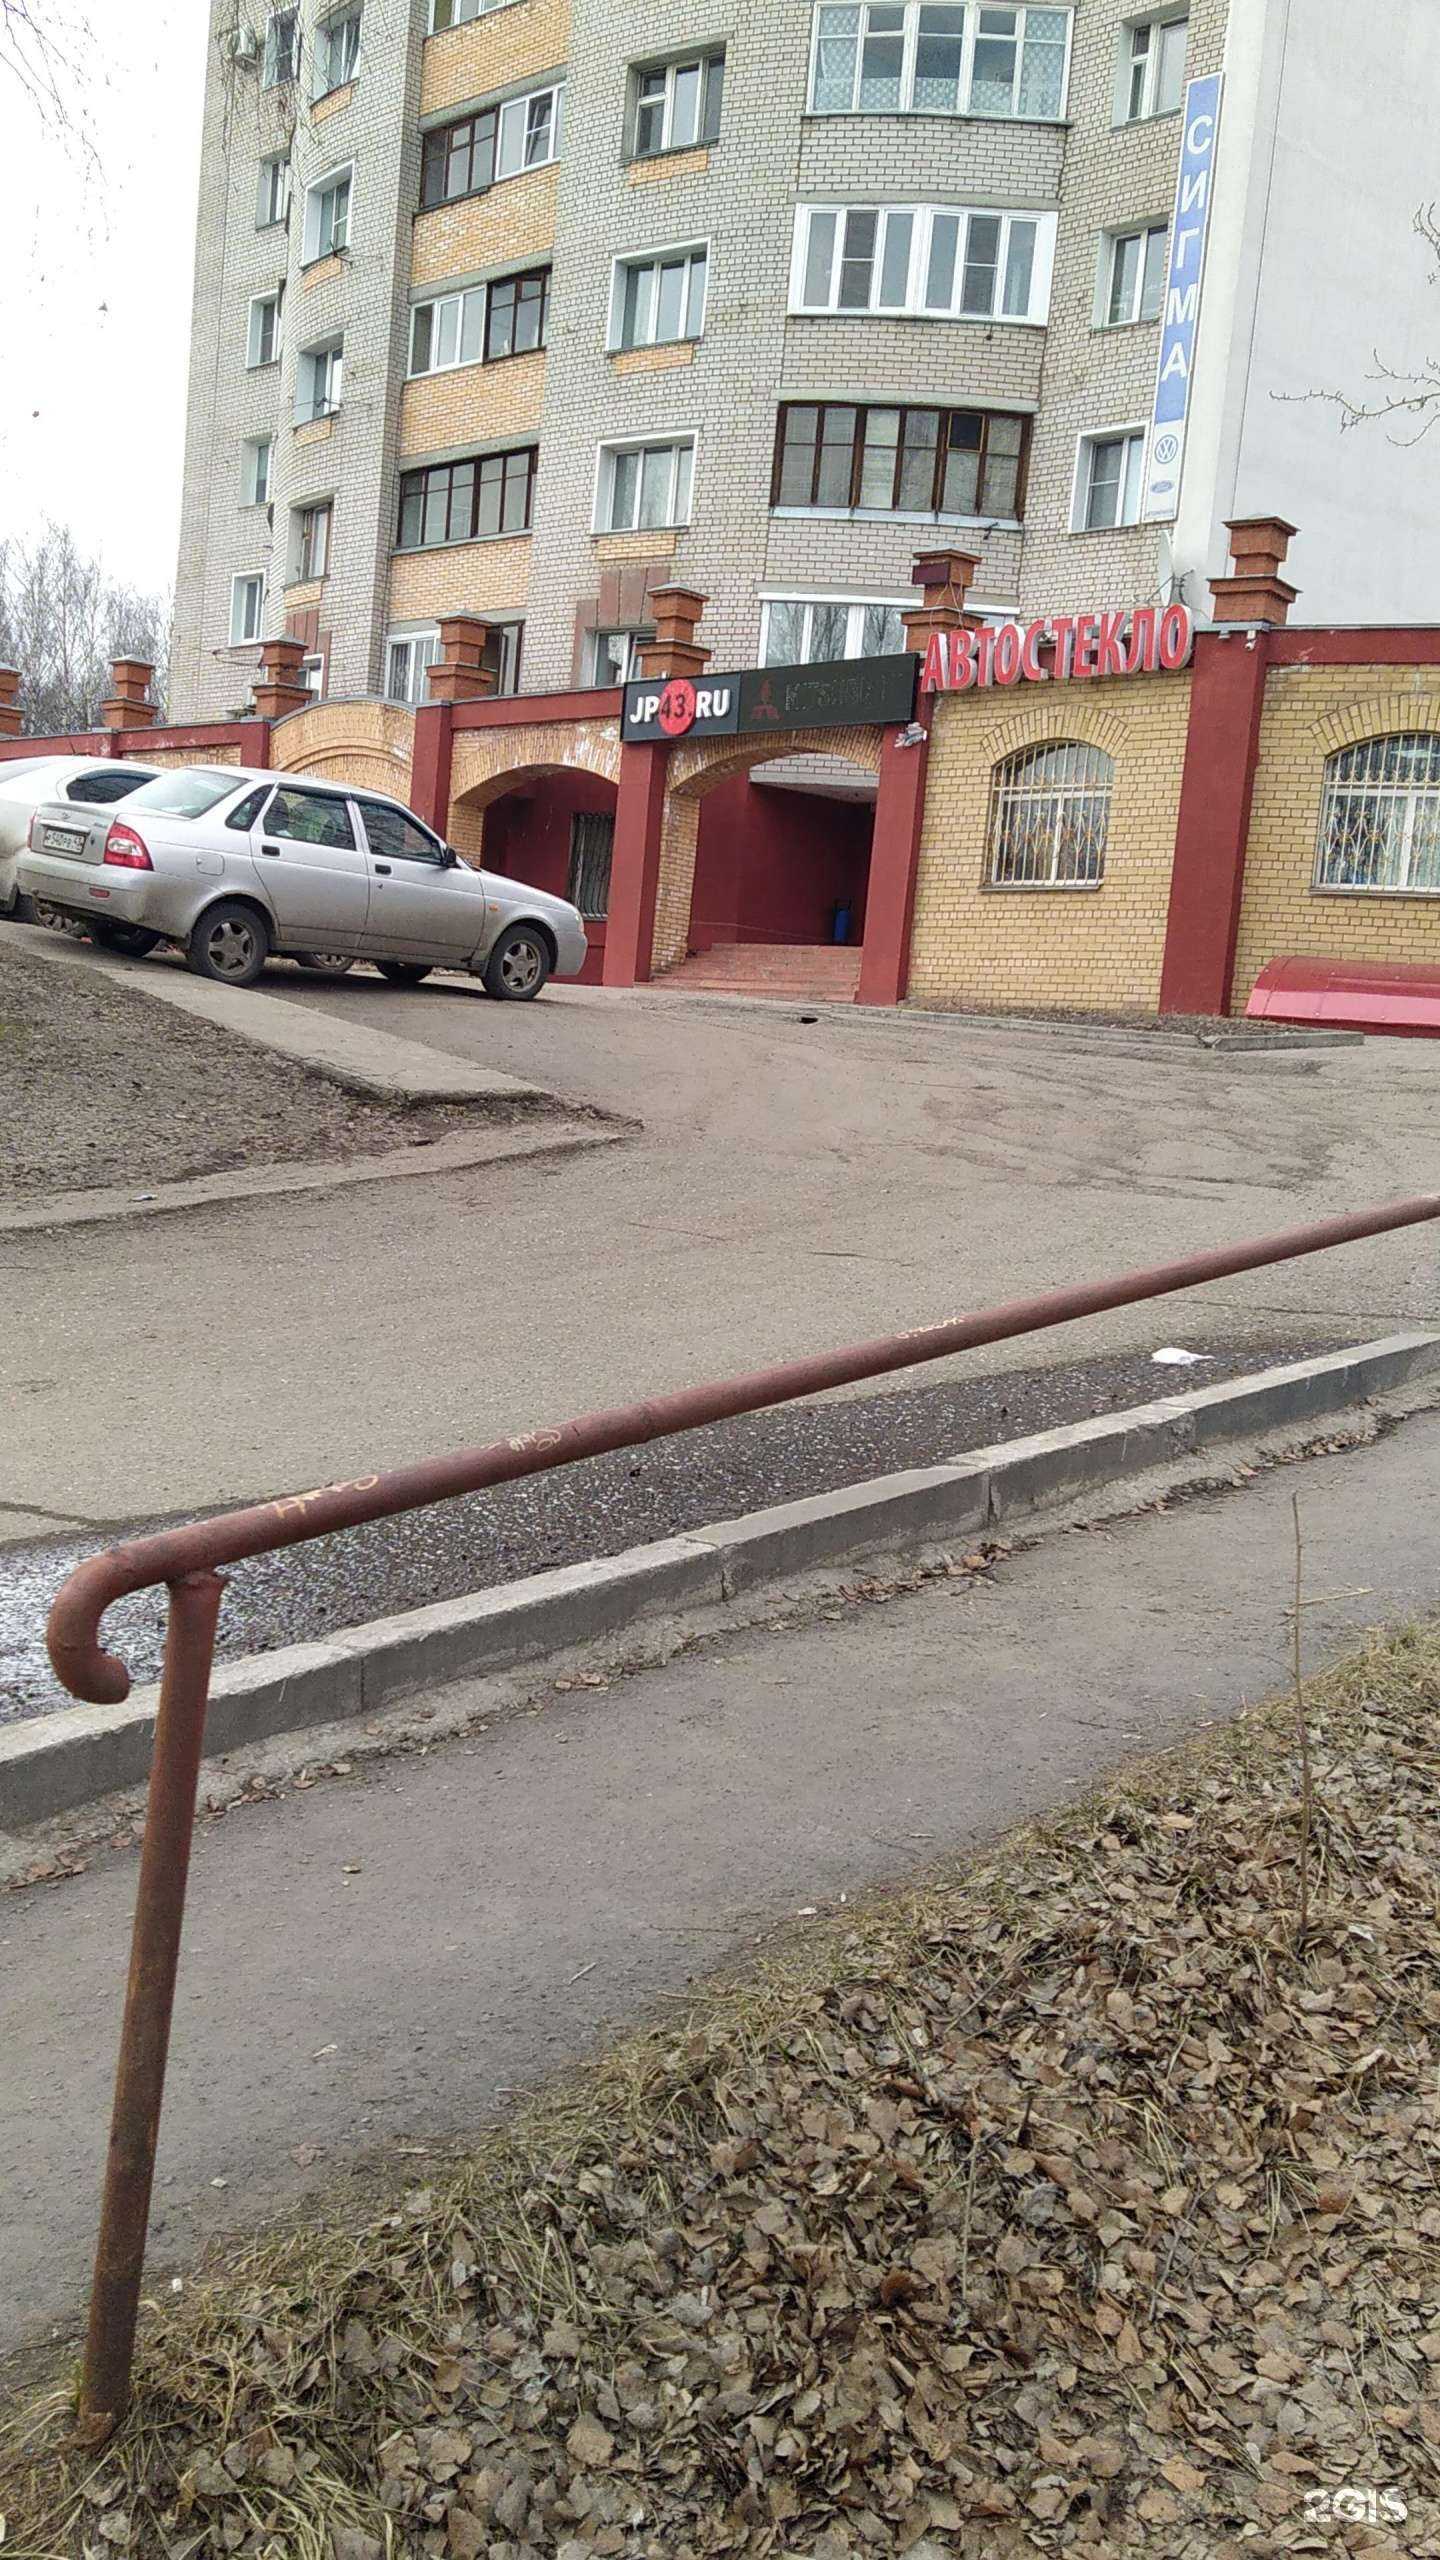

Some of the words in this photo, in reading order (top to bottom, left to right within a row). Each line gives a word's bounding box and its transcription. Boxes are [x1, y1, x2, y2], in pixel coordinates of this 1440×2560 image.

[1160, 114, 1213, 382] СИГМА
[920, 603, 1193, 693] АВТОСТЕКЛО
[629, 688, 731, 724] JP43.RU
